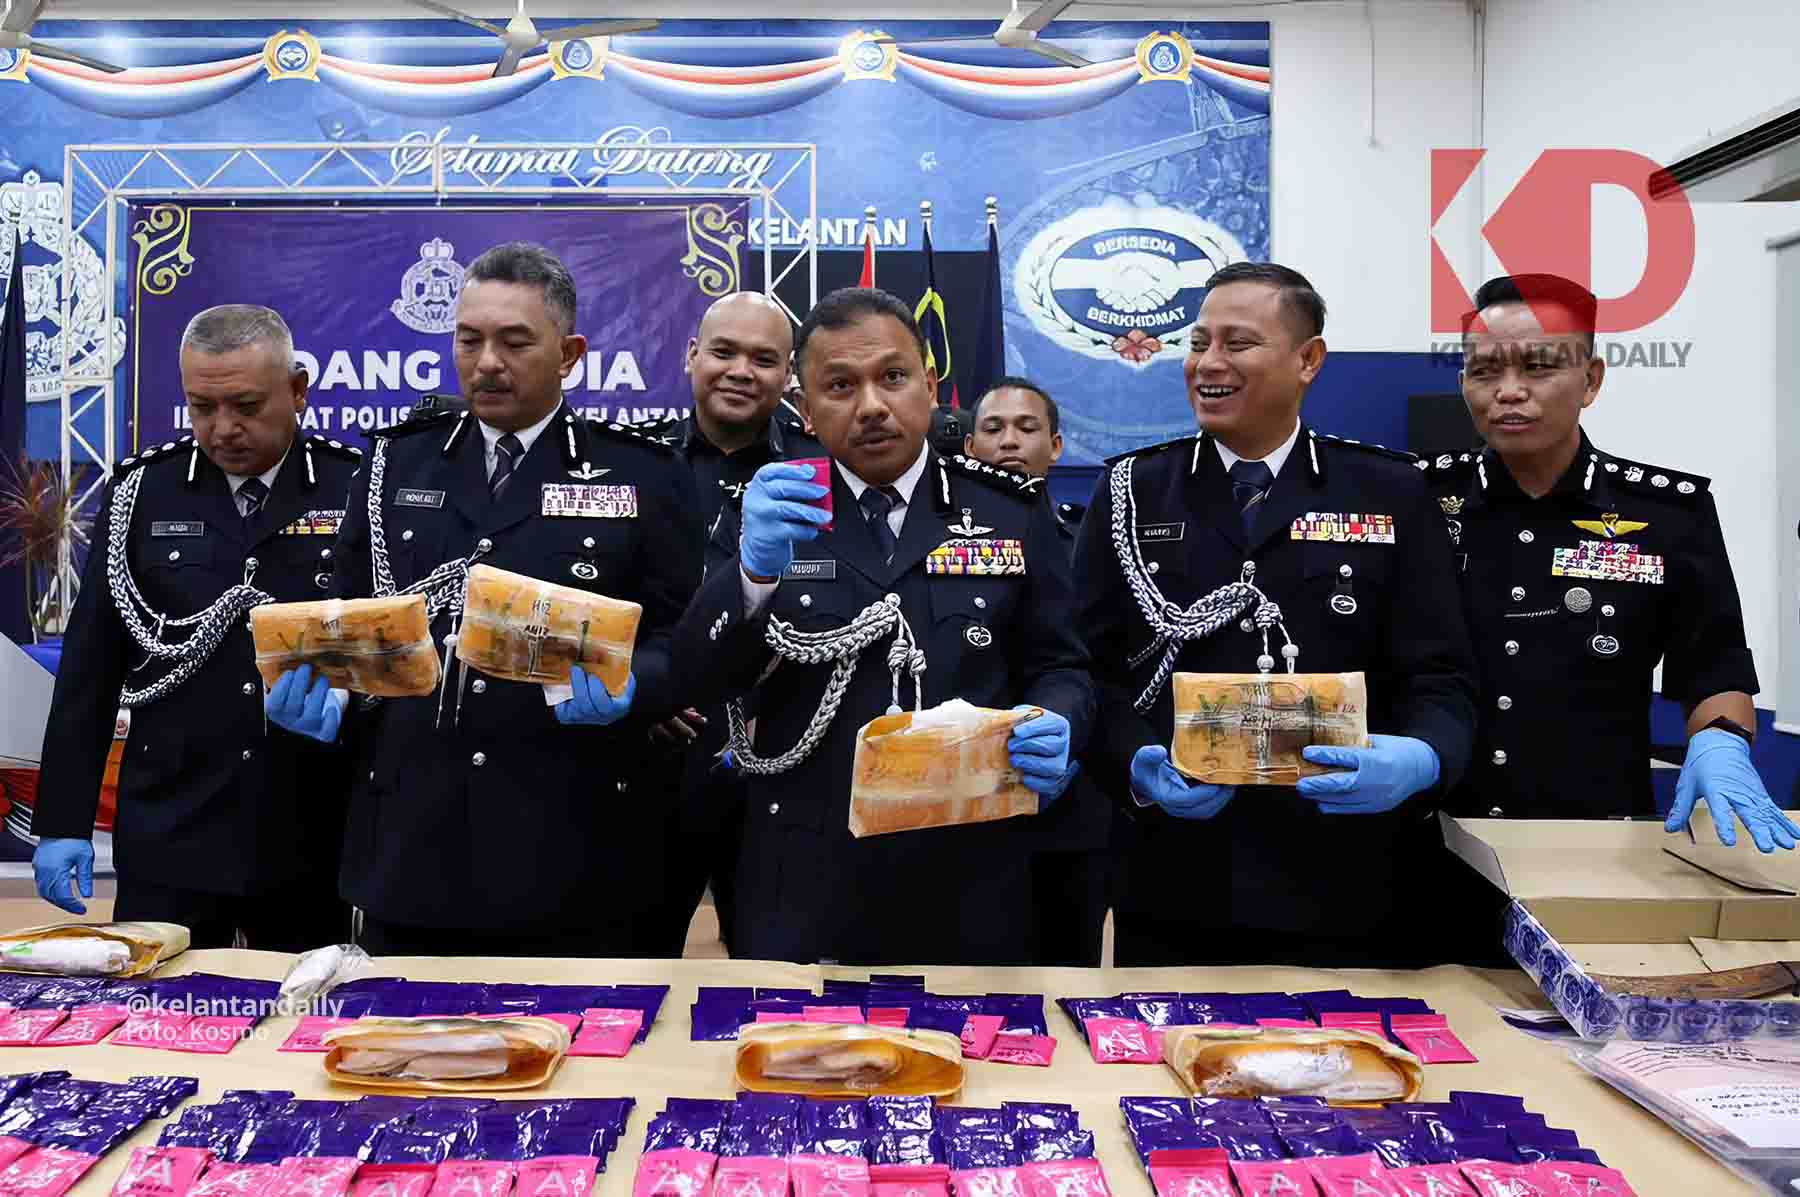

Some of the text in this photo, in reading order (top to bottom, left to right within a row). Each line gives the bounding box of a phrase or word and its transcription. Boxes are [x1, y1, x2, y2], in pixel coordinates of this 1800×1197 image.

[388, 126, 773, 188] Selamat Datang
[747, 217, 907, 246] KELANTAN
[1093, 235, 1176, 256] BERSEDIA
[1087, 306, 1186, 328] BERKHIDMAT
